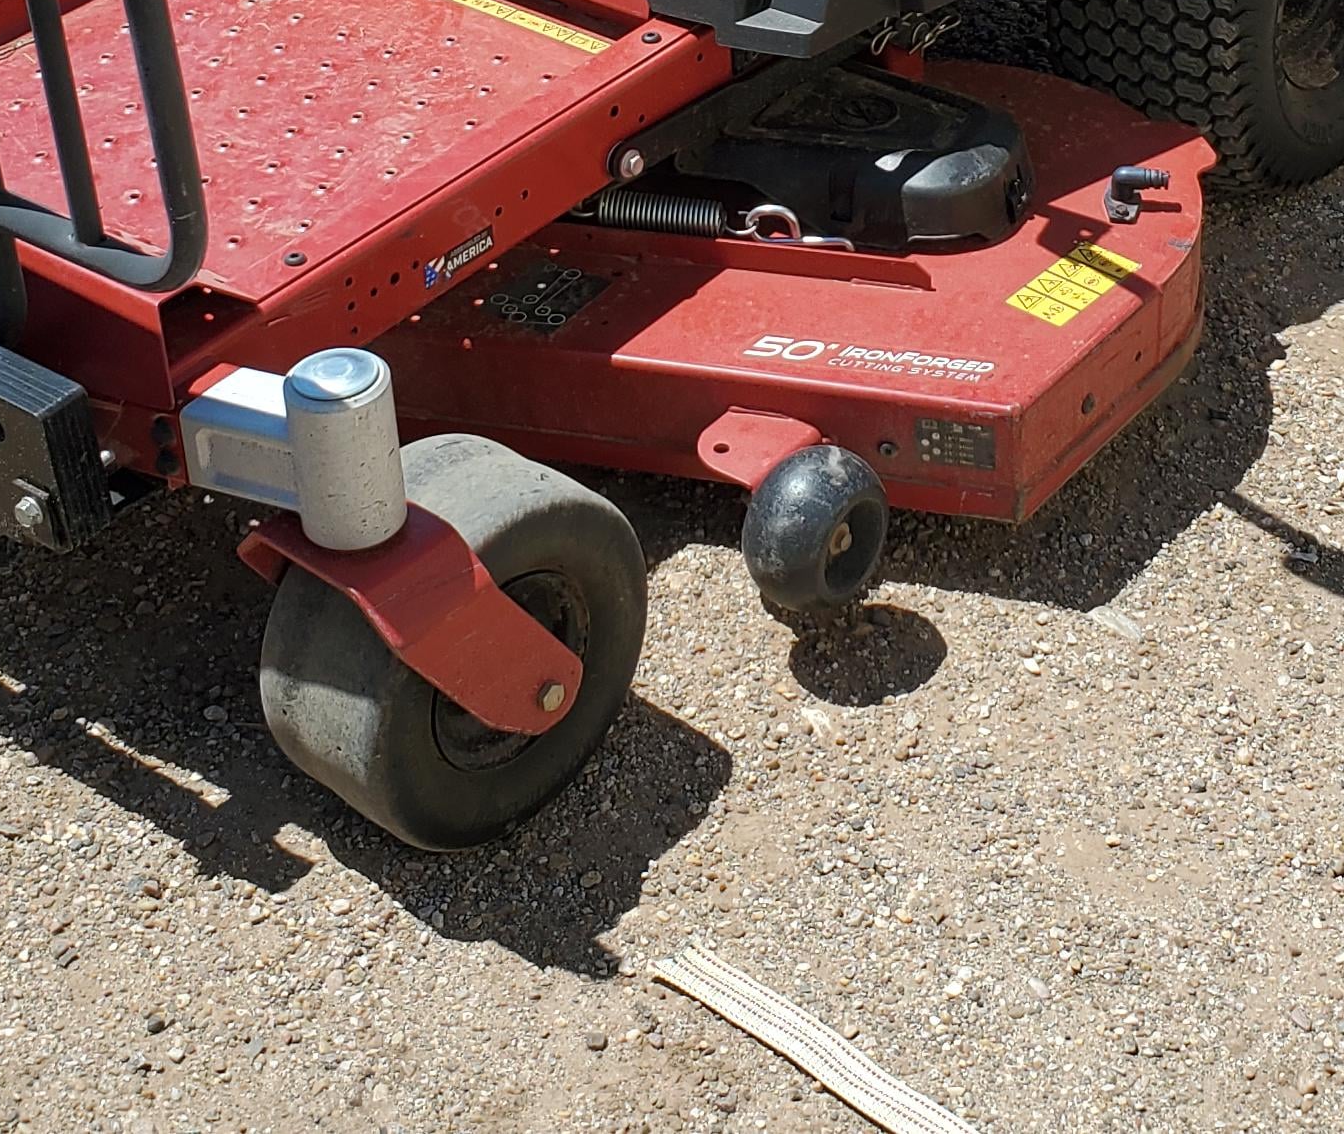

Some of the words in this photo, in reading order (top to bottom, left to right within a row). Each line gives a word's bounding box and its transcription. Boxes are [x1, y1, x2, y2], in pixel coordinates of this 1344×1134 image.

[446, 235, 493, 272] AMERICA
[827, 358, 905, 373] CUTTING
[907, 367, 982, 383] SYSTEM
[838, 345, 995, 373] IRONFORGED
